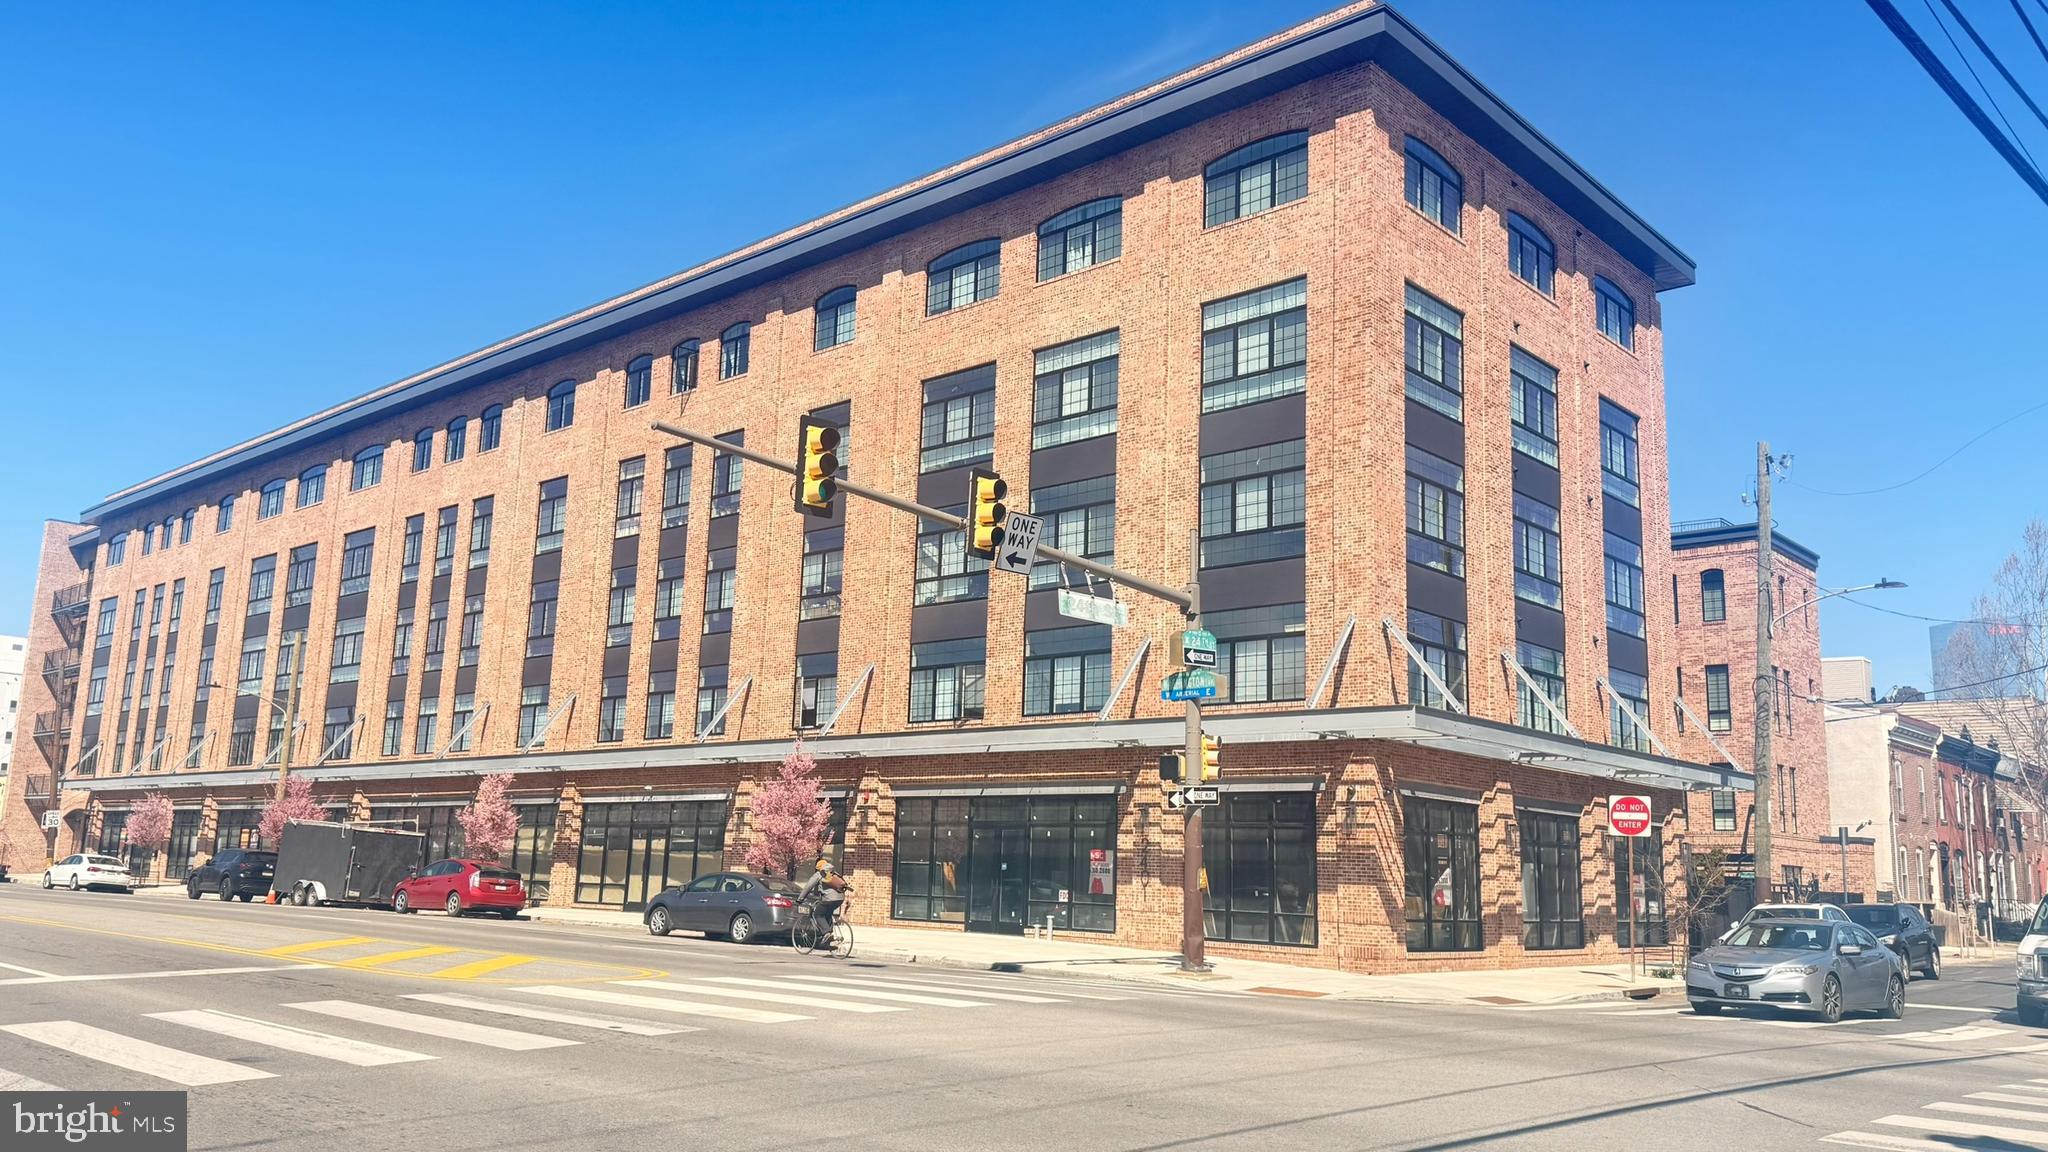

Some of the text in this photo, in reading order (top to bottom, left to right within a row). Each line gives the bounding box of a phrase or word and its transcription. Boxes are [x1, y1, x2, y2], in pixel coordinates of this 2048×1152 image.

[1012, 517, 1038, 535] ONE
[1008, 532, 1034, 550] WAY
[1205, 688, 1211, 696] E
[1615, 803, 1644, 811] DO NOT
[47, 818, 59, 826] 30
[1618, 820, 1642, 829] ENTER
